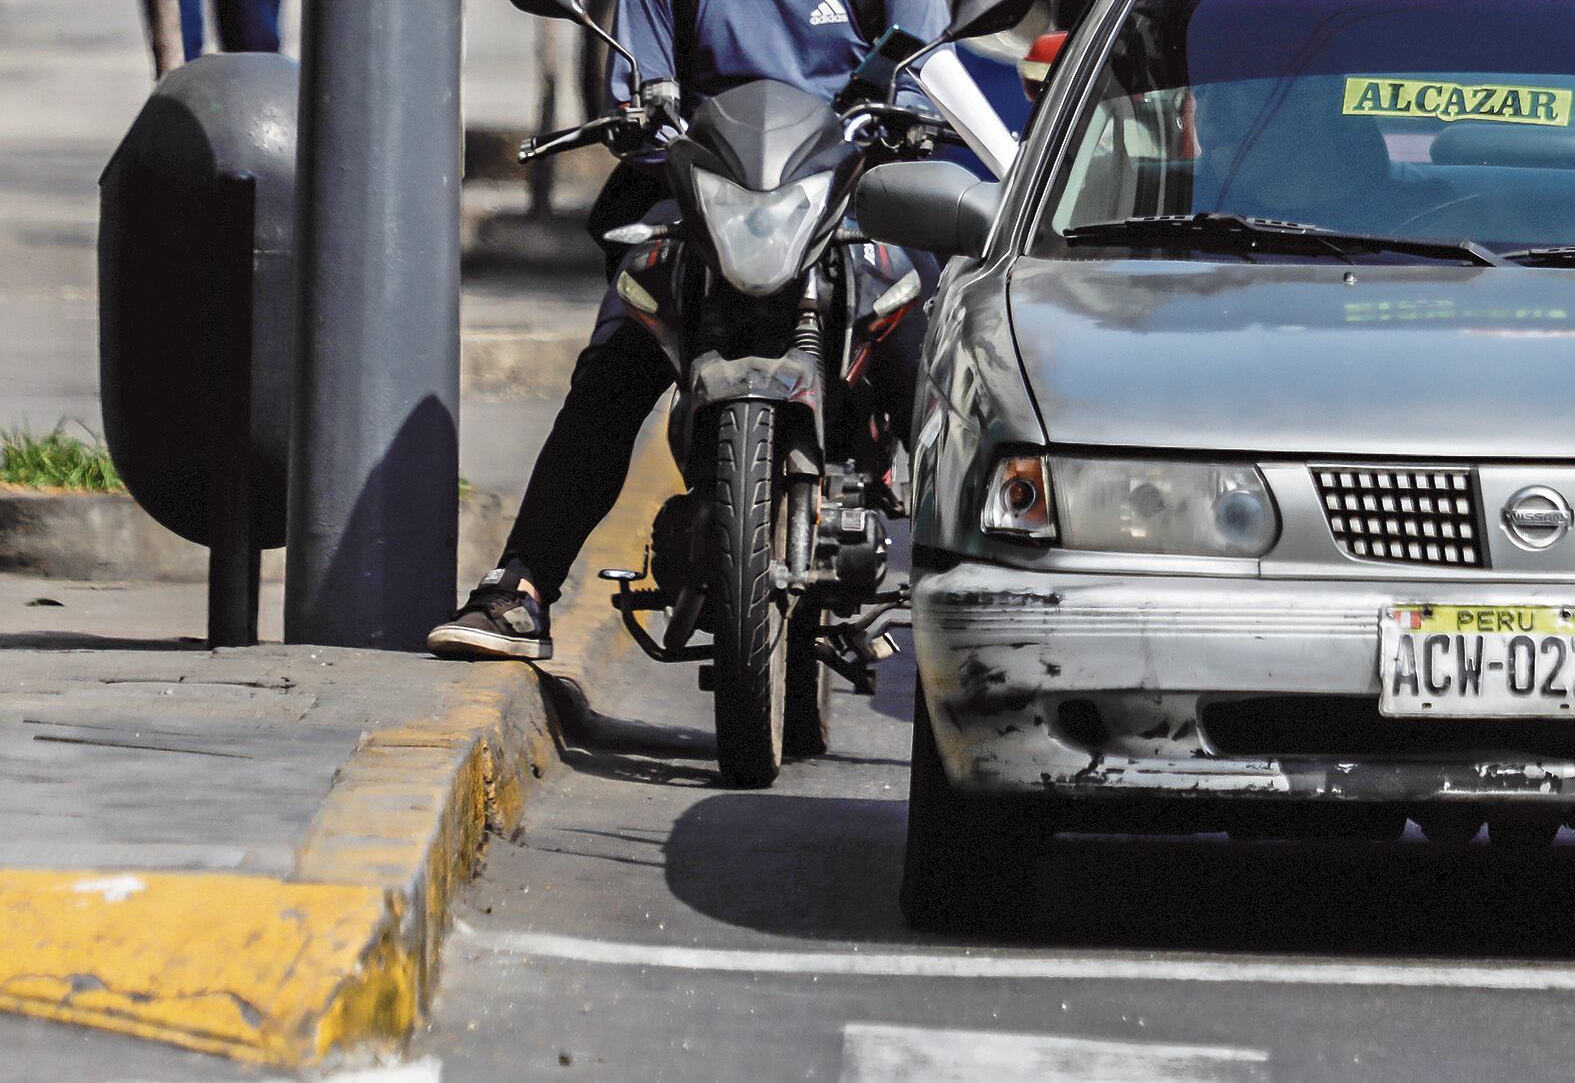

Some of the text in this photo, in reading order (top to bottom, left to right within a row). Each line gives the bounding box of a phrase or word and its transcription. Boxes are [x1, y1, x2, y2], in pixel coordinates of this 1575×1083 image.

[1352, 82, 1559, 121] ALCAZAR
[1509, 510, 1566, 523] NISSAN
[1457, 610, 1535, 632] PERU
